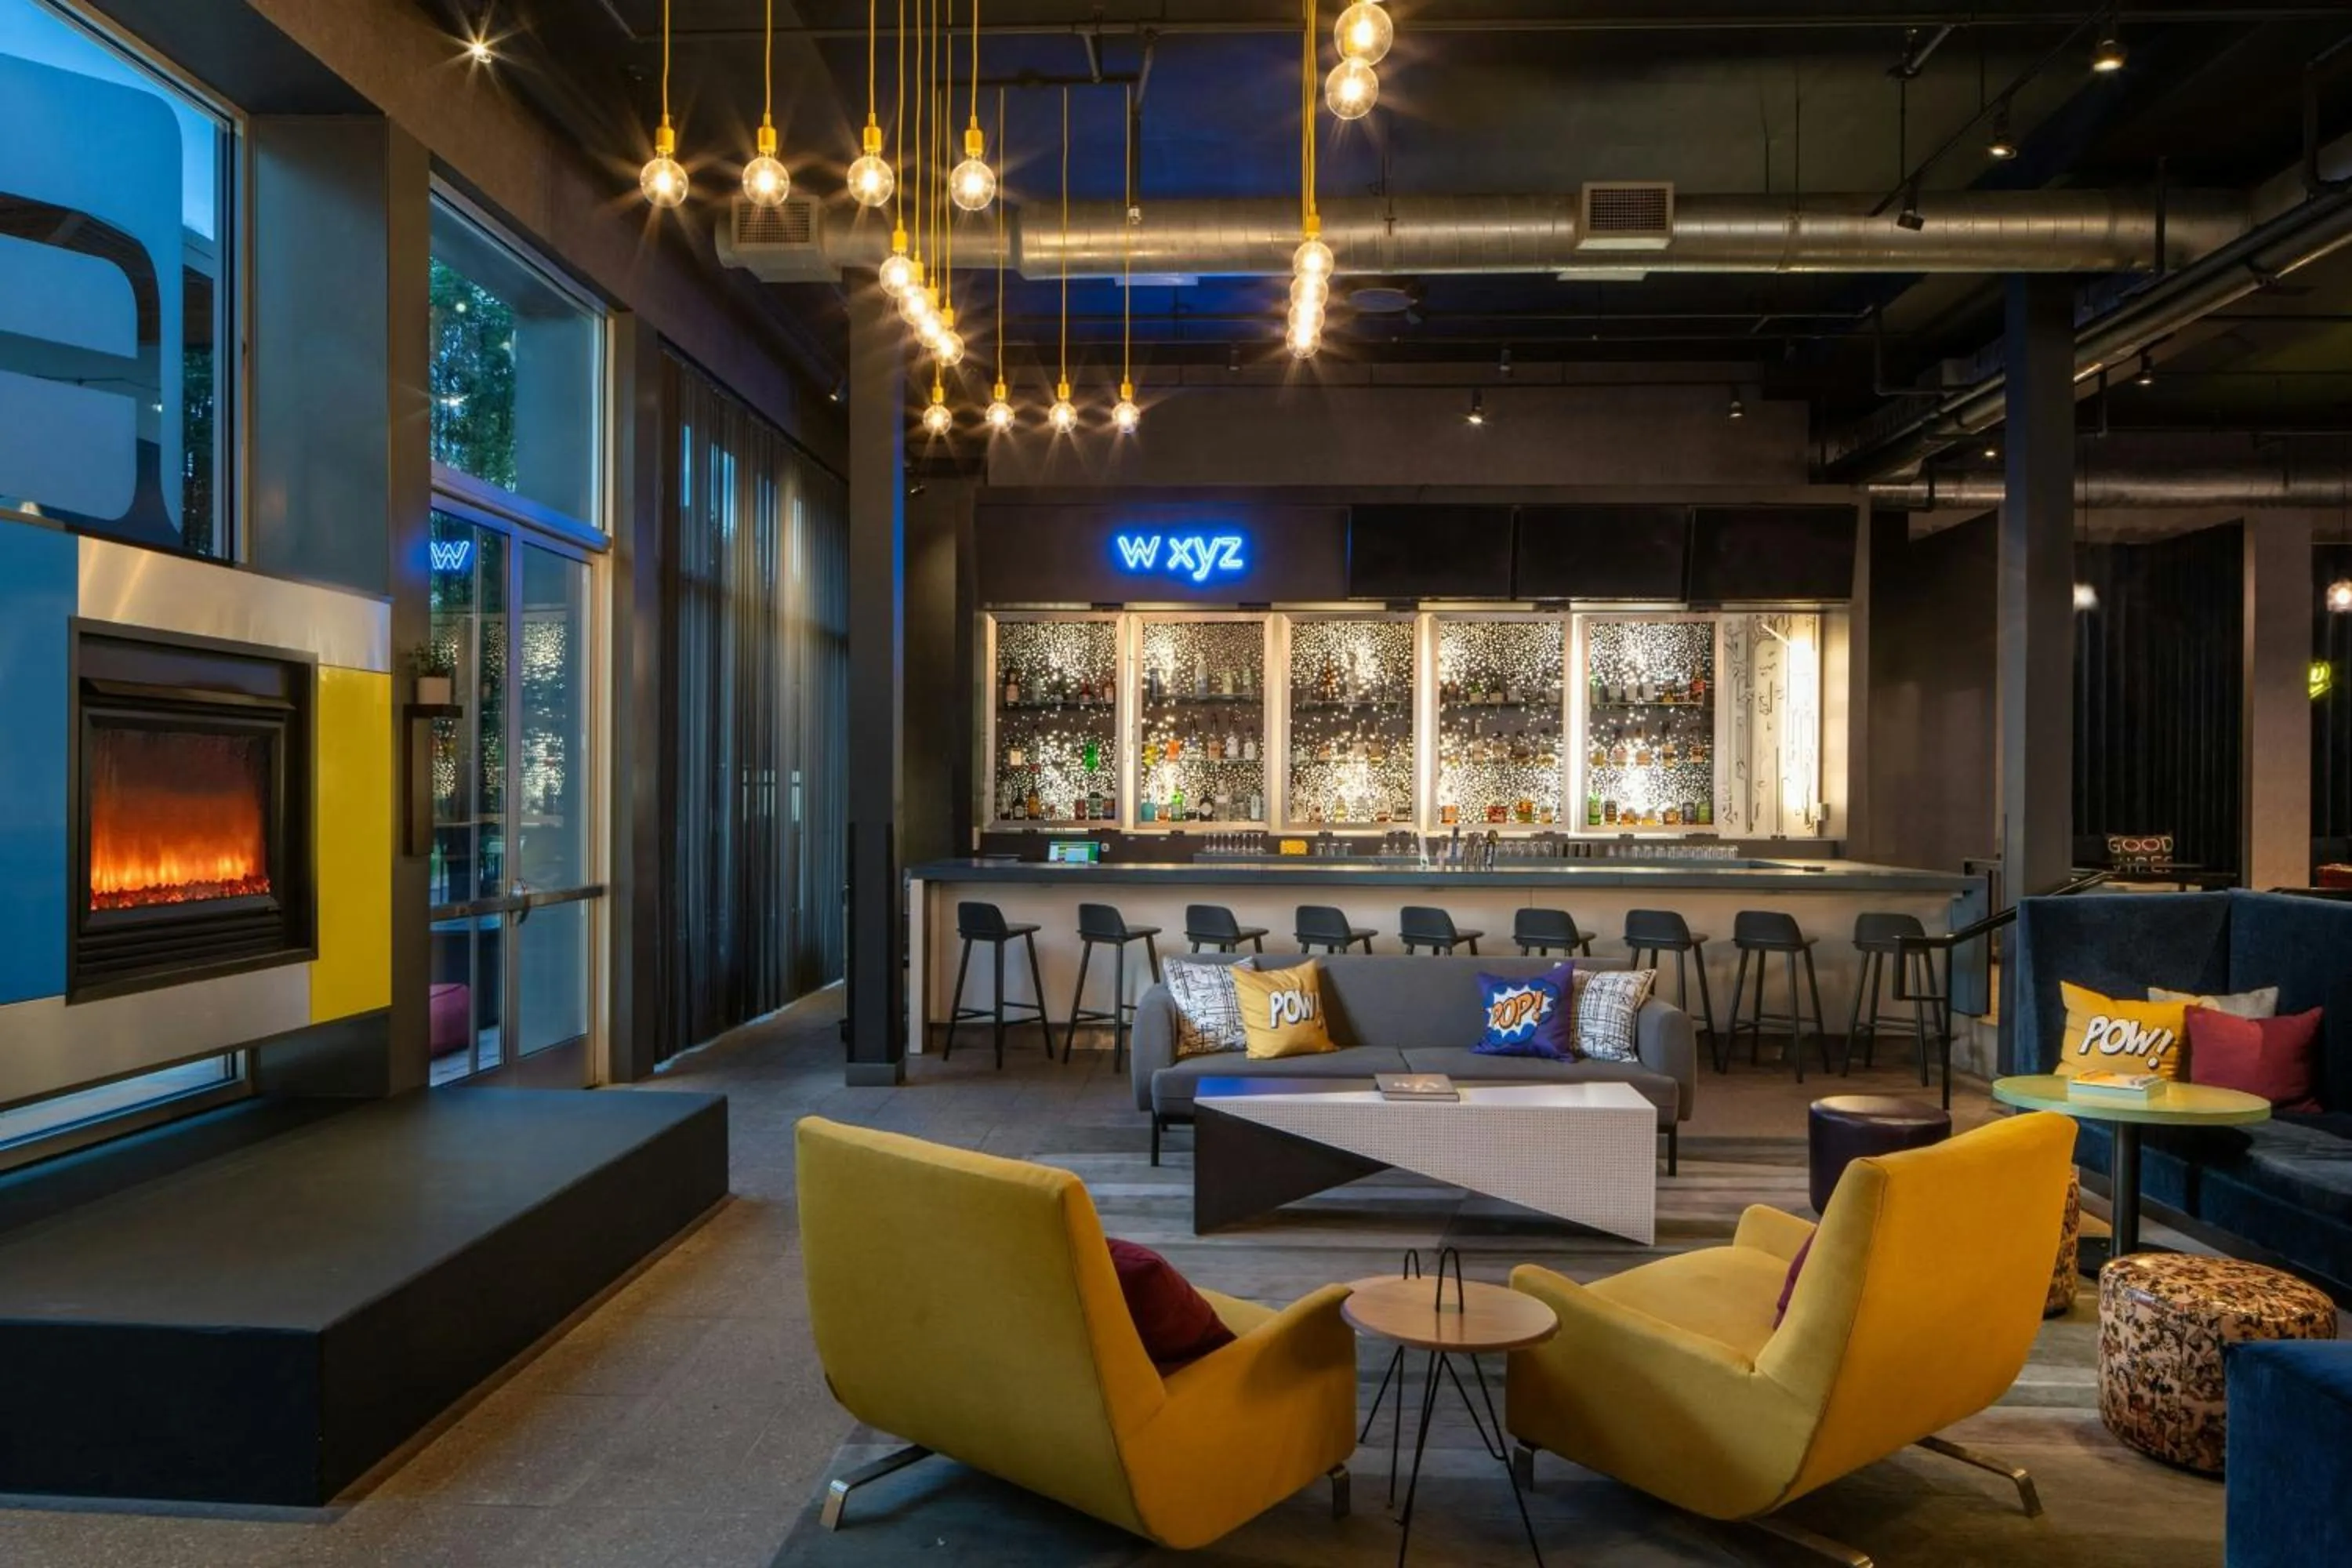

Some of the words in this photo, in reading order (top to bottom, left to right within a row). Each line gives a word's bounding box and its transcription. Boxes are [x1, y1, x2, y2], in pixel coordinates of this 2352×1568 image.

[2107, 836, 2174, 854] GOOD
[1491, 990, 1544, 1029] POP!
[2077, 1014, 2175, 1069] POW!
